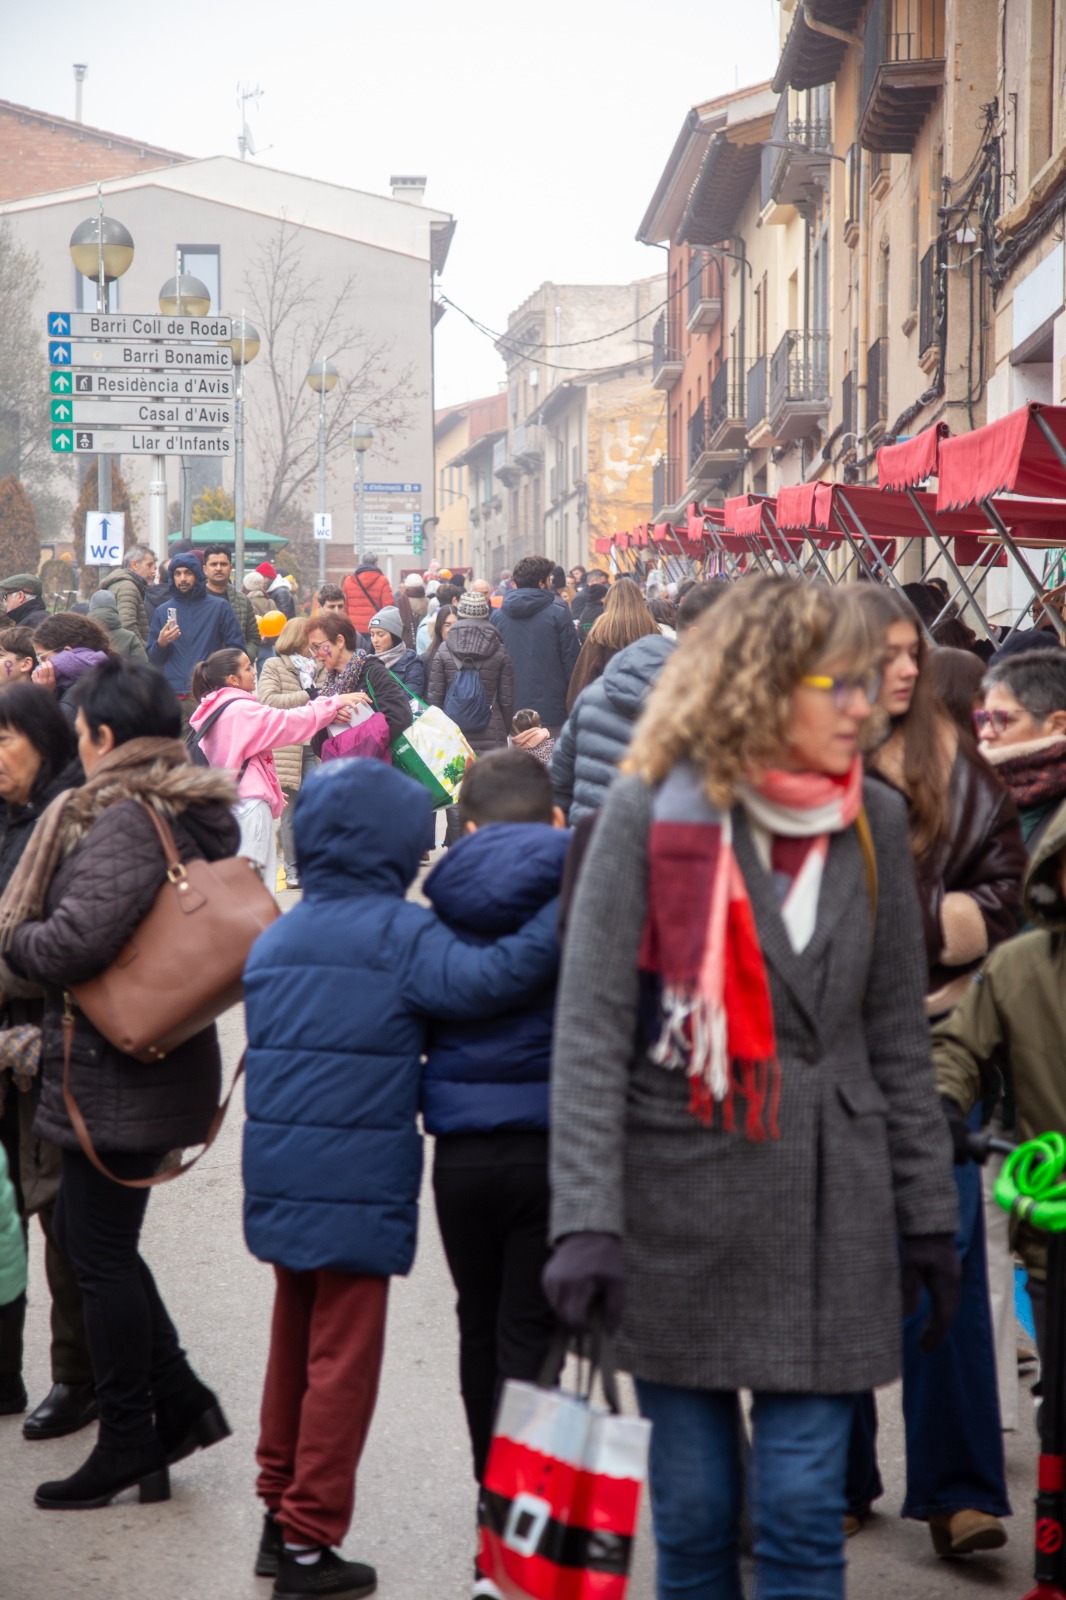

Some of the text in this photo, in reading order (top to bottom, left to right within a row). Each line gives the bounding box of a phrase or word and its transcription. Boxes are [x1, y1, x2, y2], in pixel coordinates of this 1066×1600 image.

[91, 318, 228, 336] Barri Coll de Roda
[123, 348, 228, 365] Barri Bonamic
[97, 376, 229, 394] Residència d'Avis
[139, 406, 230, 423] Casal d'Avis
[132, 435, 230, 451] Llar d'Infants
[90, 545, 120, 559] WC
